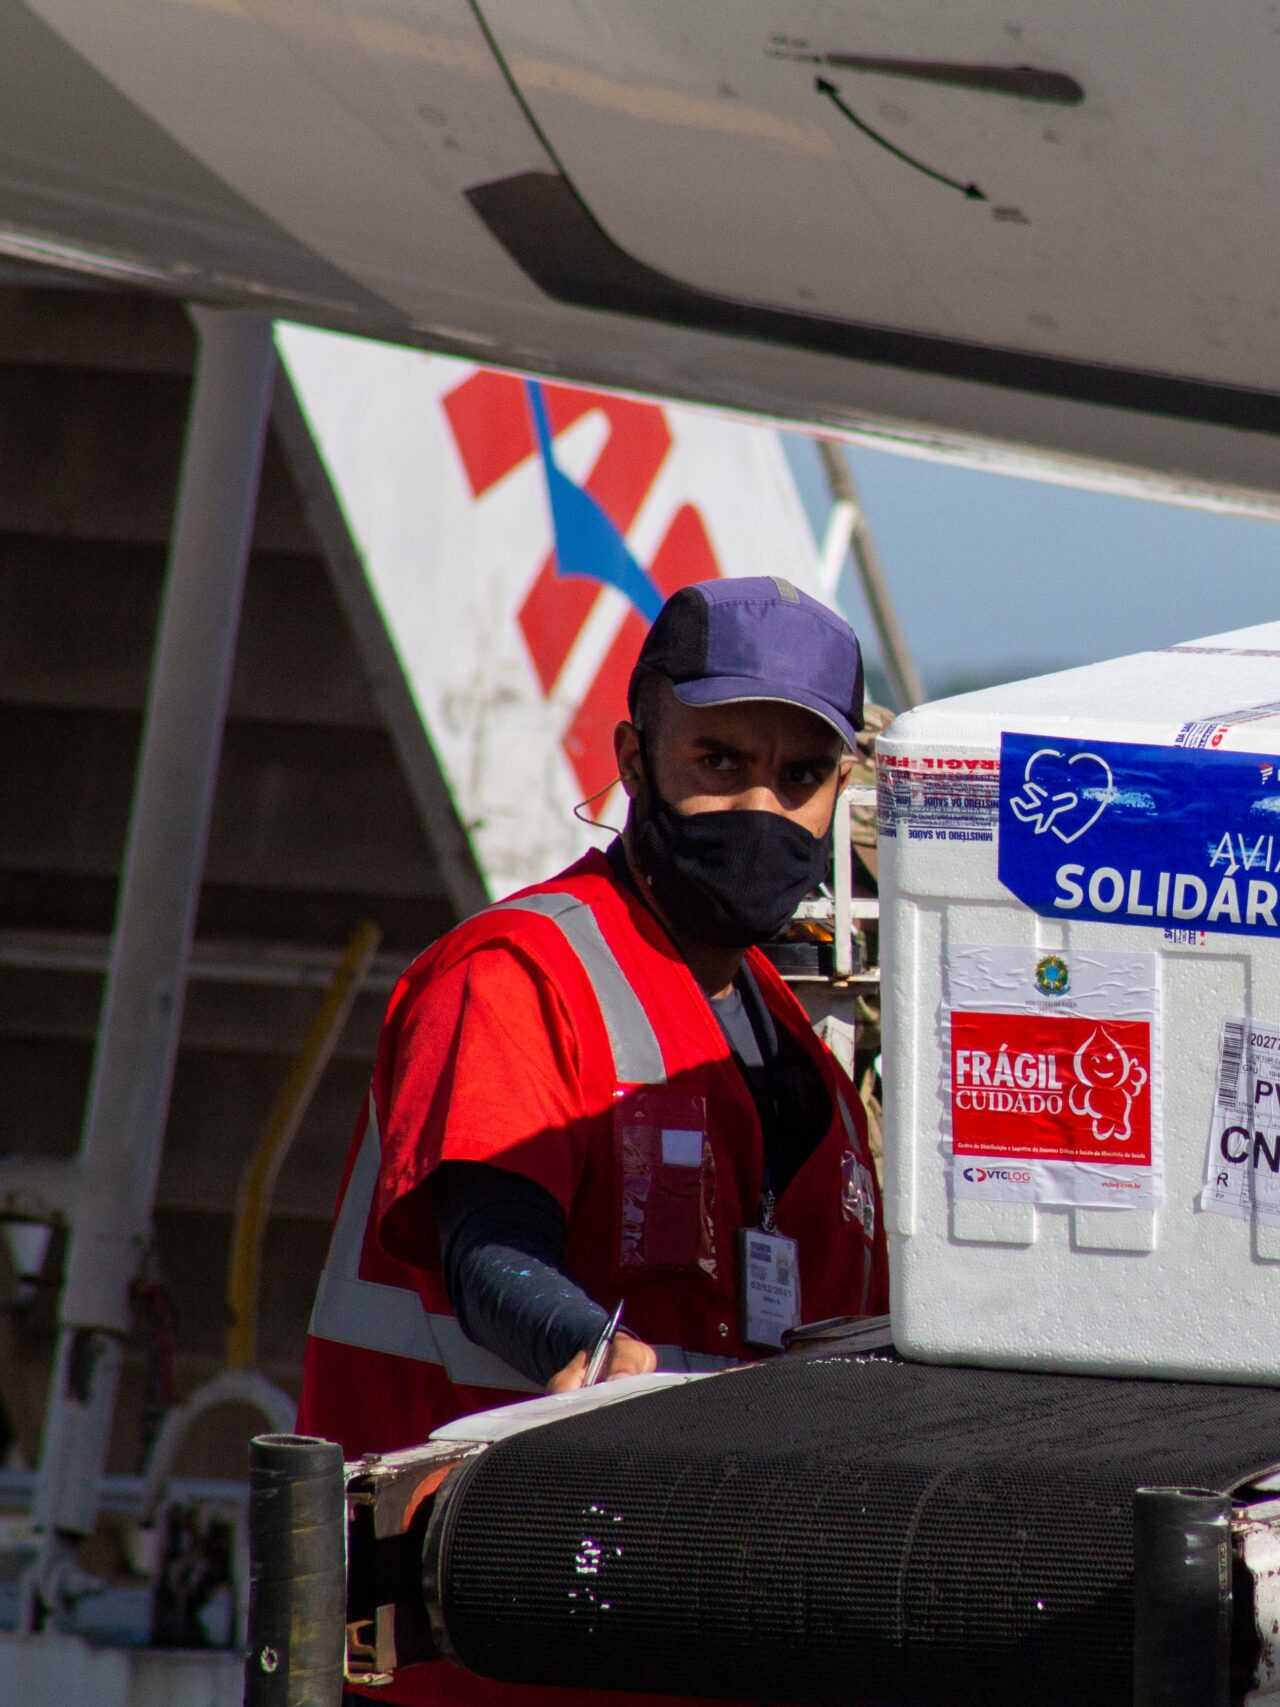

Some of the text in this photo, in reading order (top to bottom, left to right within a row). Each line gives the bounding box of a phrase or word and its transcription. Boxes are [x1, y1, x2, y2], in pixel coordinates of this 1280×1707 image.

[908, 829, 933, 841] SAÚDE
[936, 830, 946, 840] DA
[949, 830, 992, 842] MINISTÉRIO
[956, 1043, 1063, 1089] FRÁGIL
[956, 1090, 1063, 1115] CUIDADO
[987, 1170, 1031, 1181] VTCLOG
[1217, 1172, 1228, 1187] R
